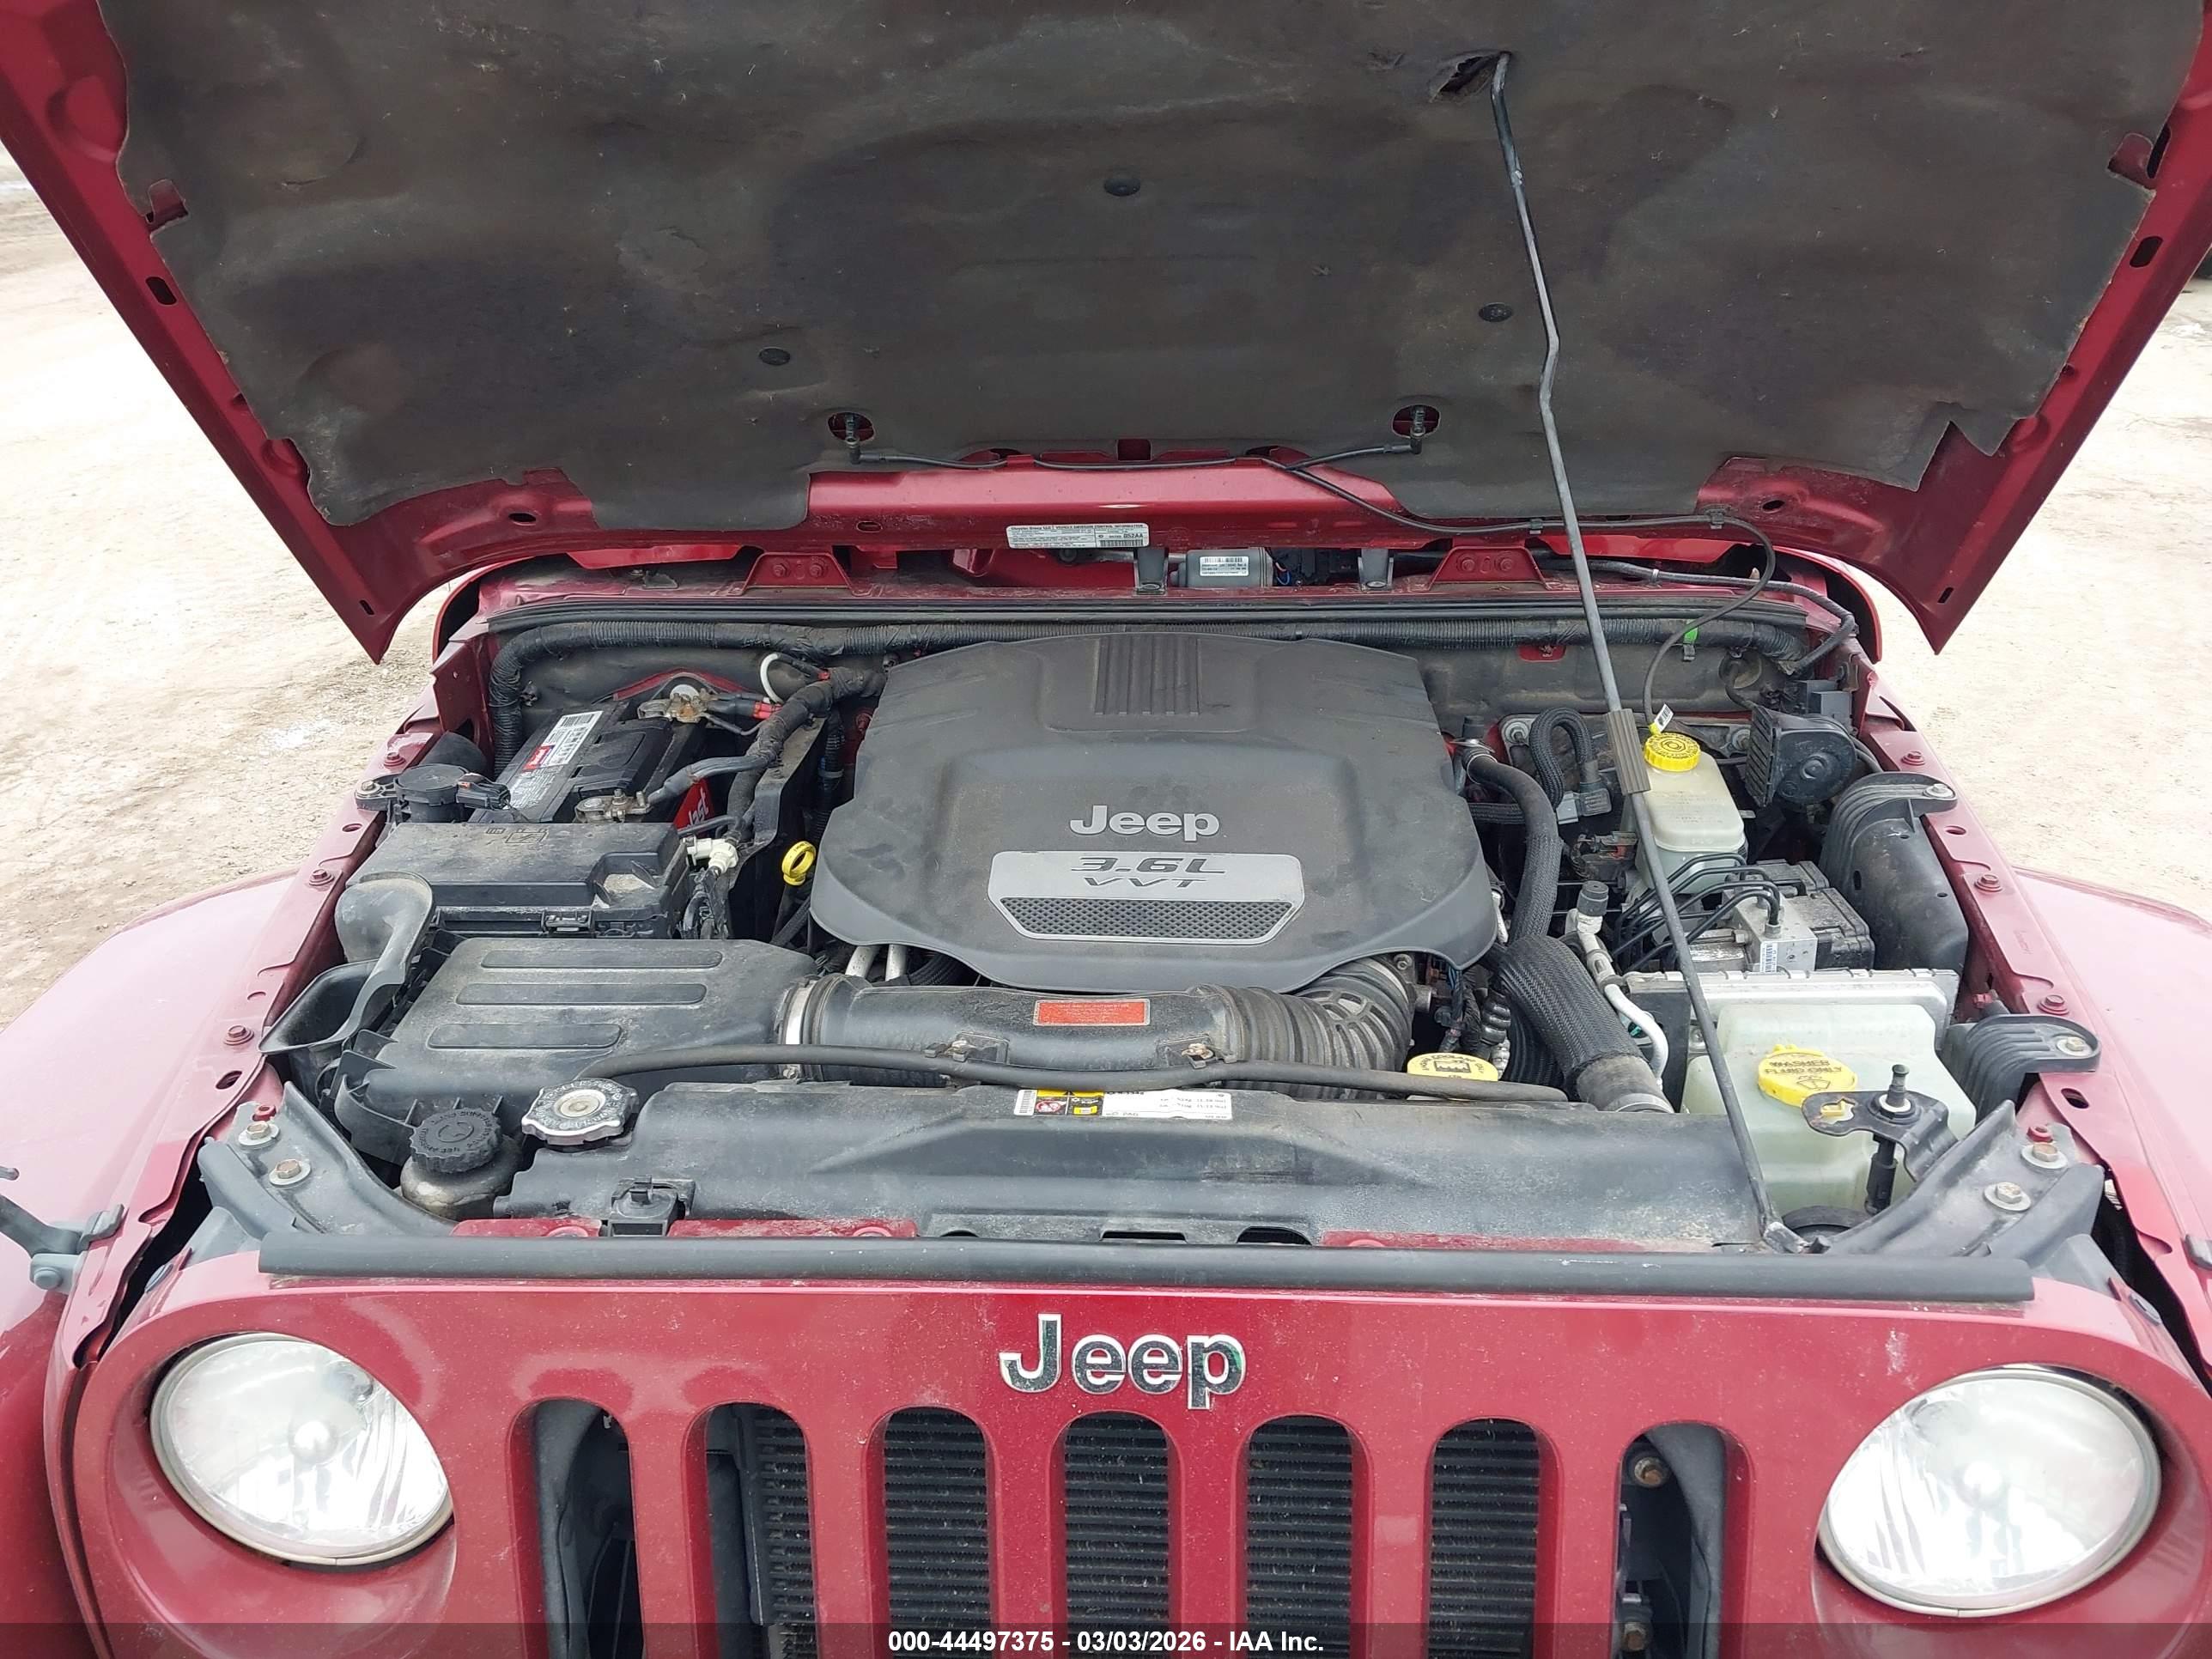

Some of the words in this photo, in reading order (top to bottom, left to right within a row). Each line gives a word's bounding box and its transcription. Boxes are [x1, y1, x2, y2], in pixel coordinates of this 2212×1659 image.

[1069, 805, 1220, 842] Jeep
[1071, 856, 1226, 873] 3.6L
[1084, 877, 1207, 888] VVT
[998, 1313, 1247, 1410] Jeep
